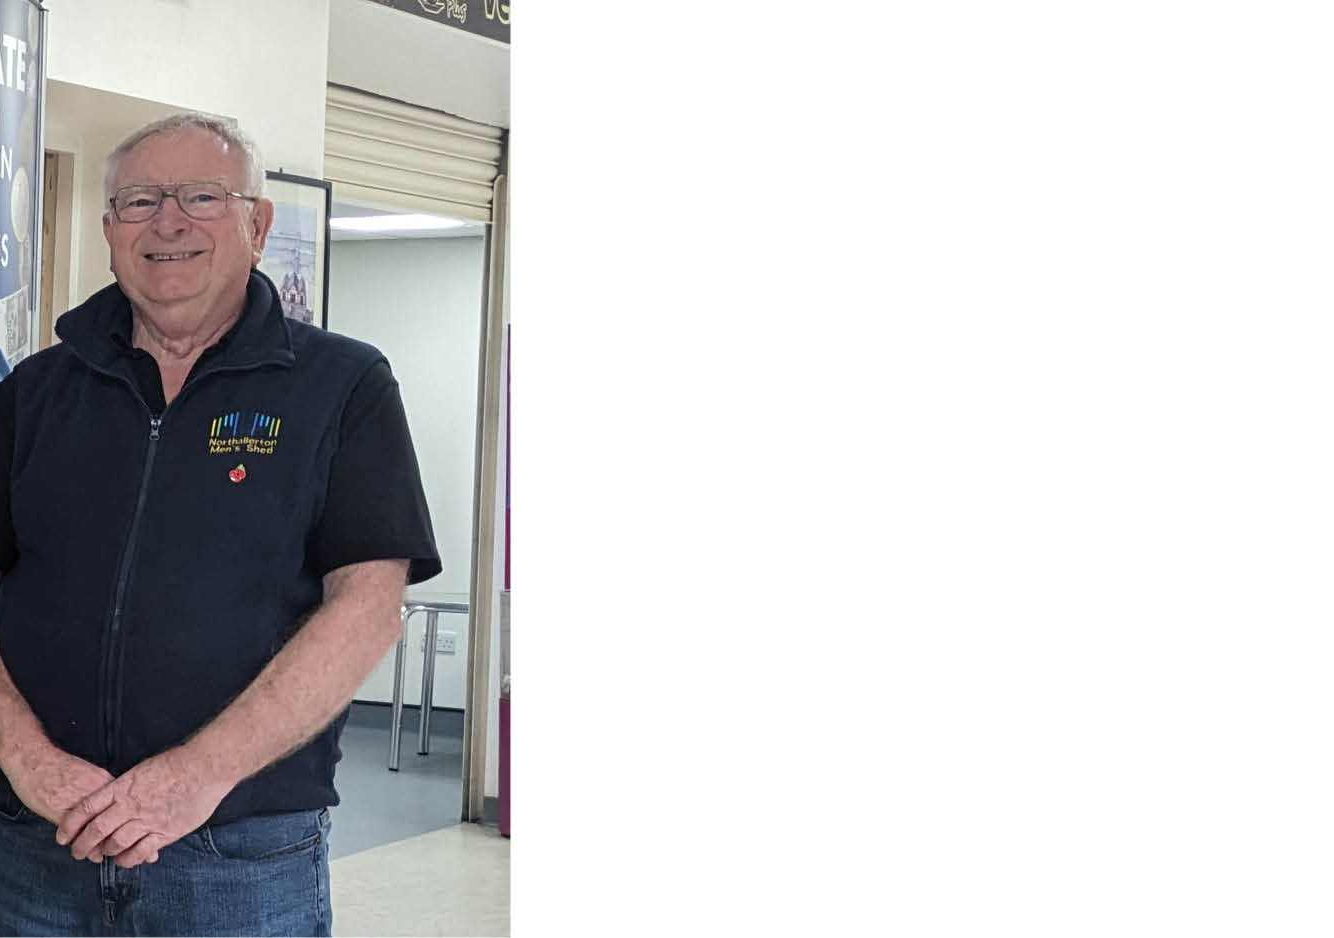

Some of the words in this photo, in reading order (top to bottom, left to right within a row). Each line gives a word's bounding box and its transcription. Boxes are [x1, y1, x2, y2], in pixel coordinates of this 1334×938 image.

[209, 437, 277, 446] Northallerton
[210, 445, 240, 454] Men's
[246, 444, 273, 454] Shed
